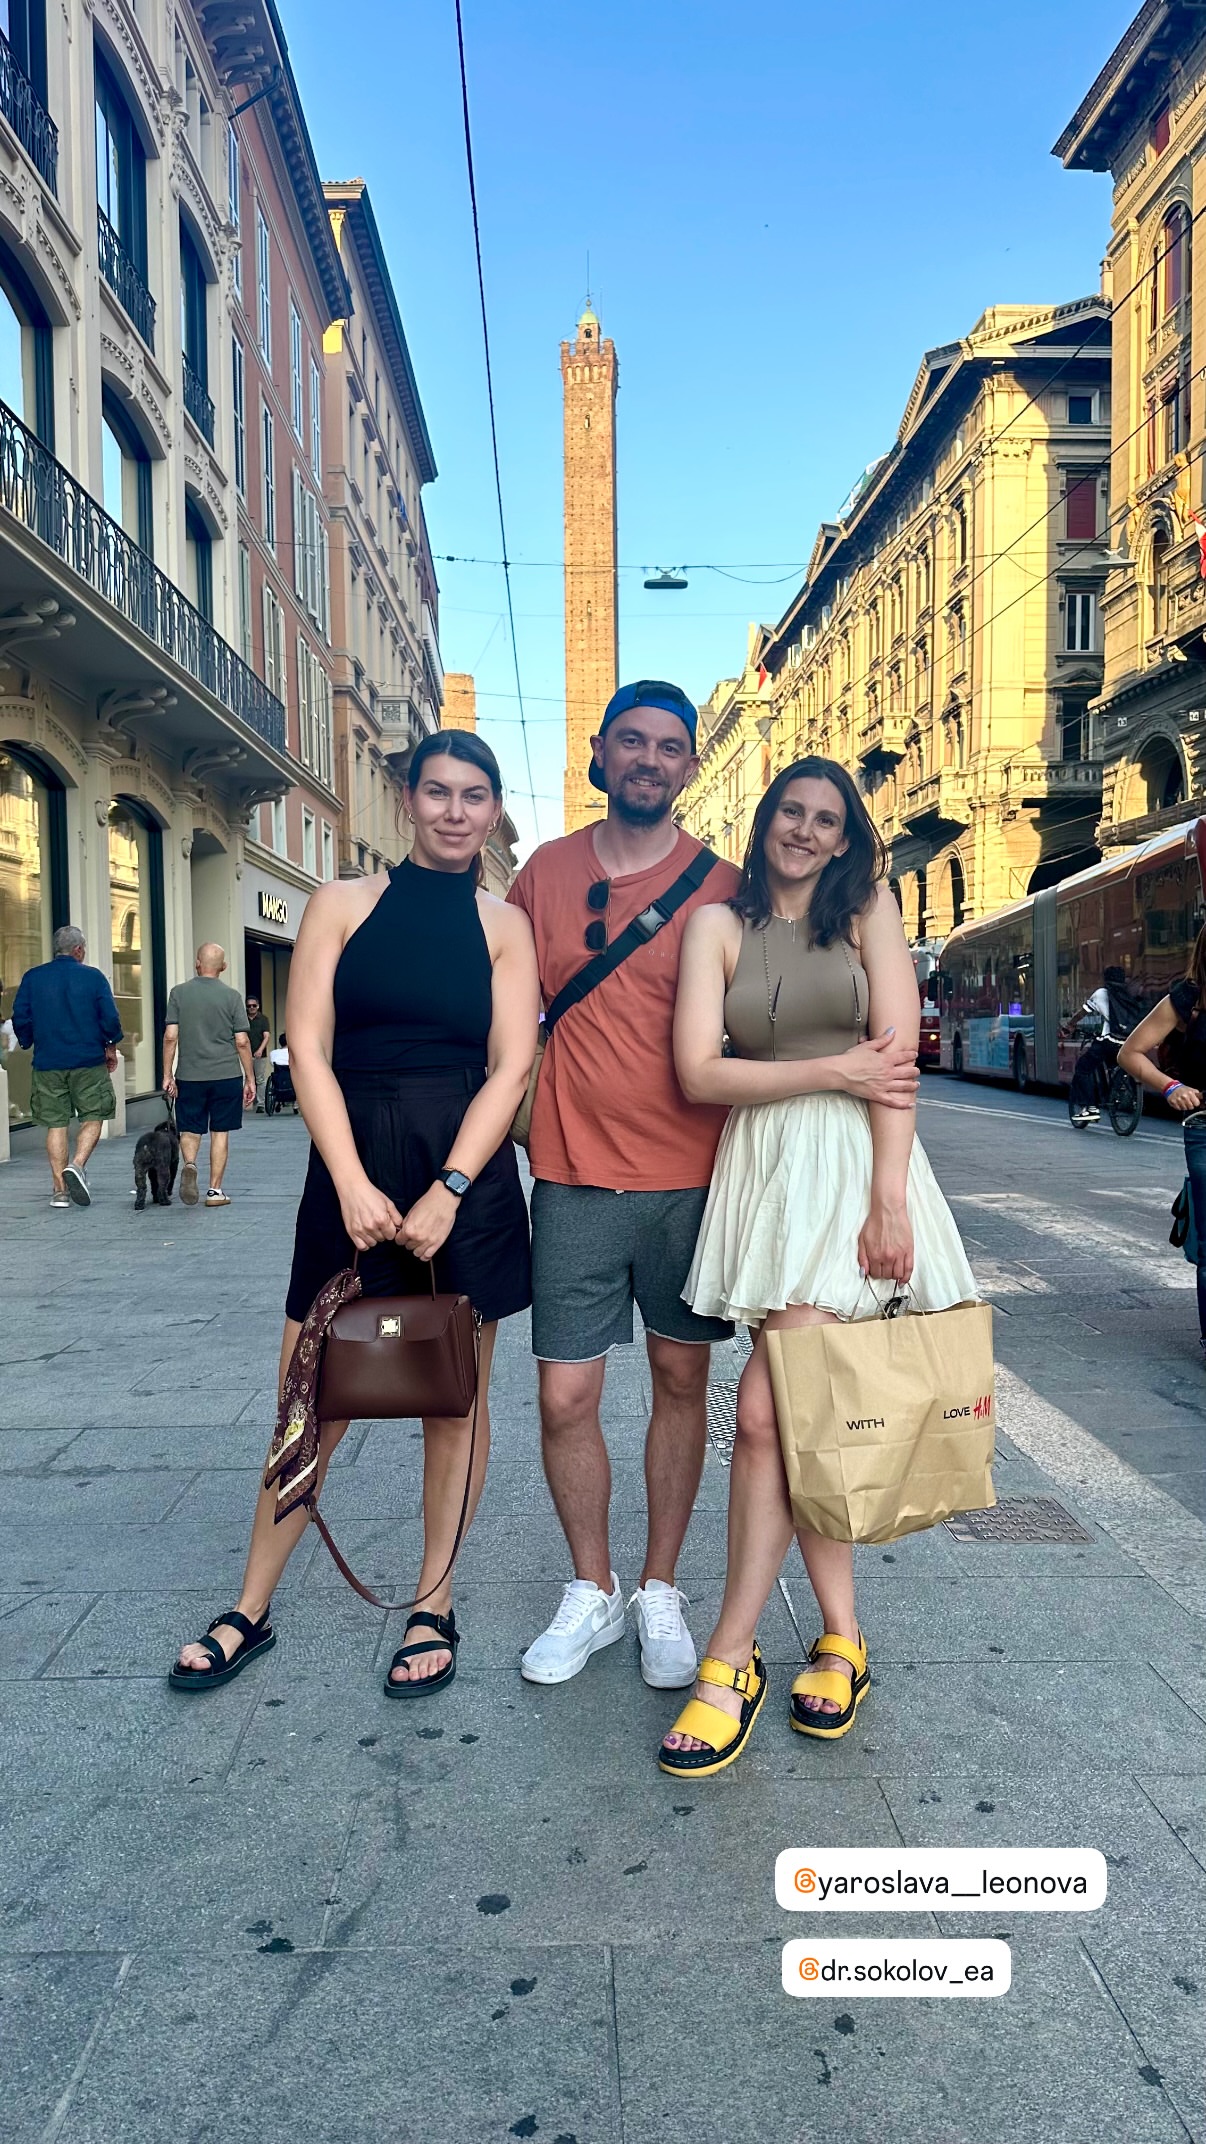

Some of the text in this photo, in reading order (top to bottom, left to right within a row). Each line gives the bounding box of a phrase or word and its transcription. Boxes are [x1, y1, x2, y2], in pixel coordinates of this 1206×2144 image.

[260, 891, 288, 924] MANGO
[846, 1418, 885, 1430] WITH
[943, 1406, 971, 1419] LOVE
